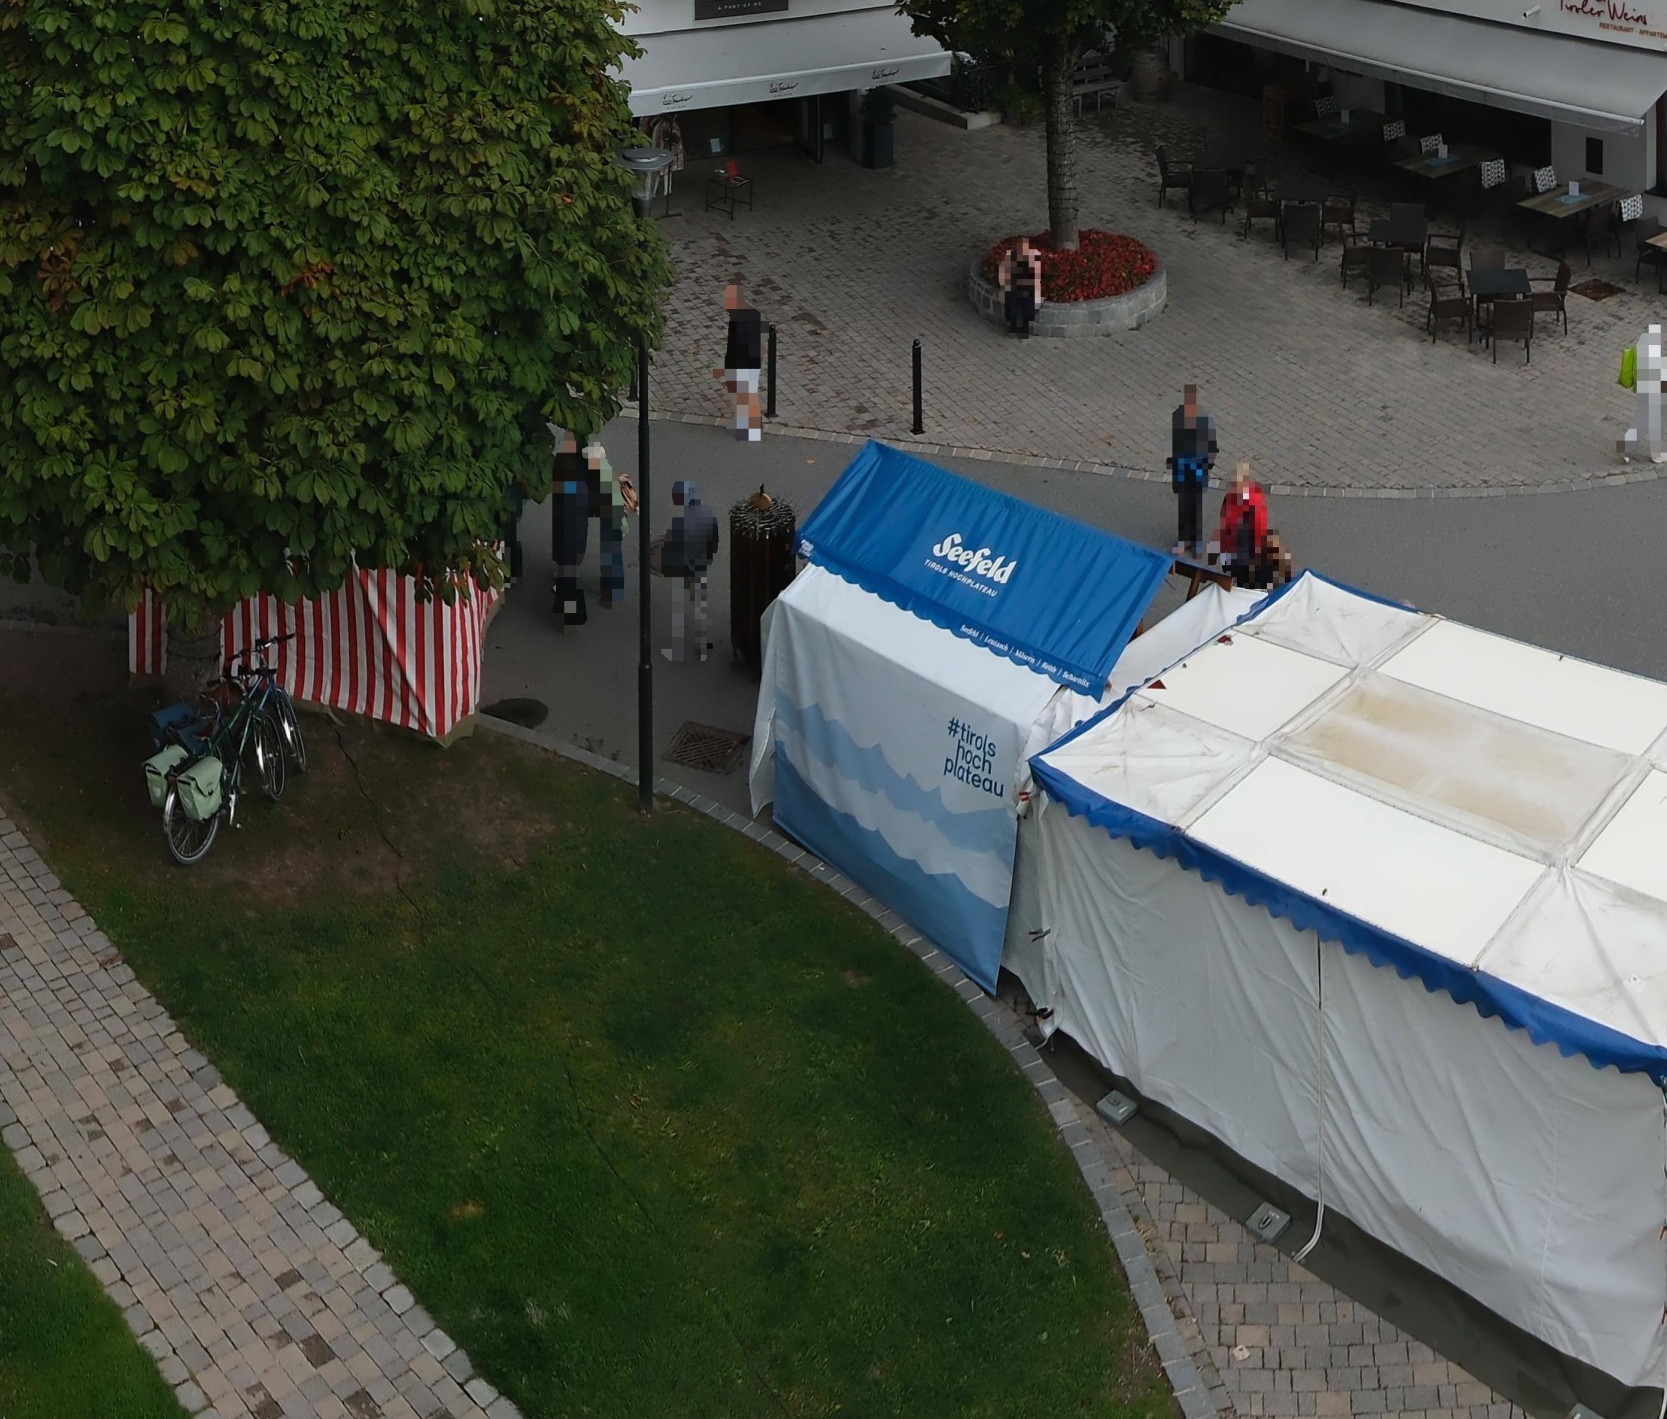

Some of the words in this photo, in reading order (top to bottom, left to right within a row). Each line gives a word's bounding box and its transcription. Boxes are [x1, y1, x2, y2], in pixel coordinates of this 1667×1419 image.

[1599, 22, 1634, 33] RESTAURANT
[923, 558, 948, 575] TIROLS
[948, 569, 999, 597] HOCHPLATEAU
[932, 532, 1018, 585] Seefeld
[947, 717, 997, 756] #tirols
[955, 739, 992, 774] hoch
[943, 757, 1005, 798] plateau
